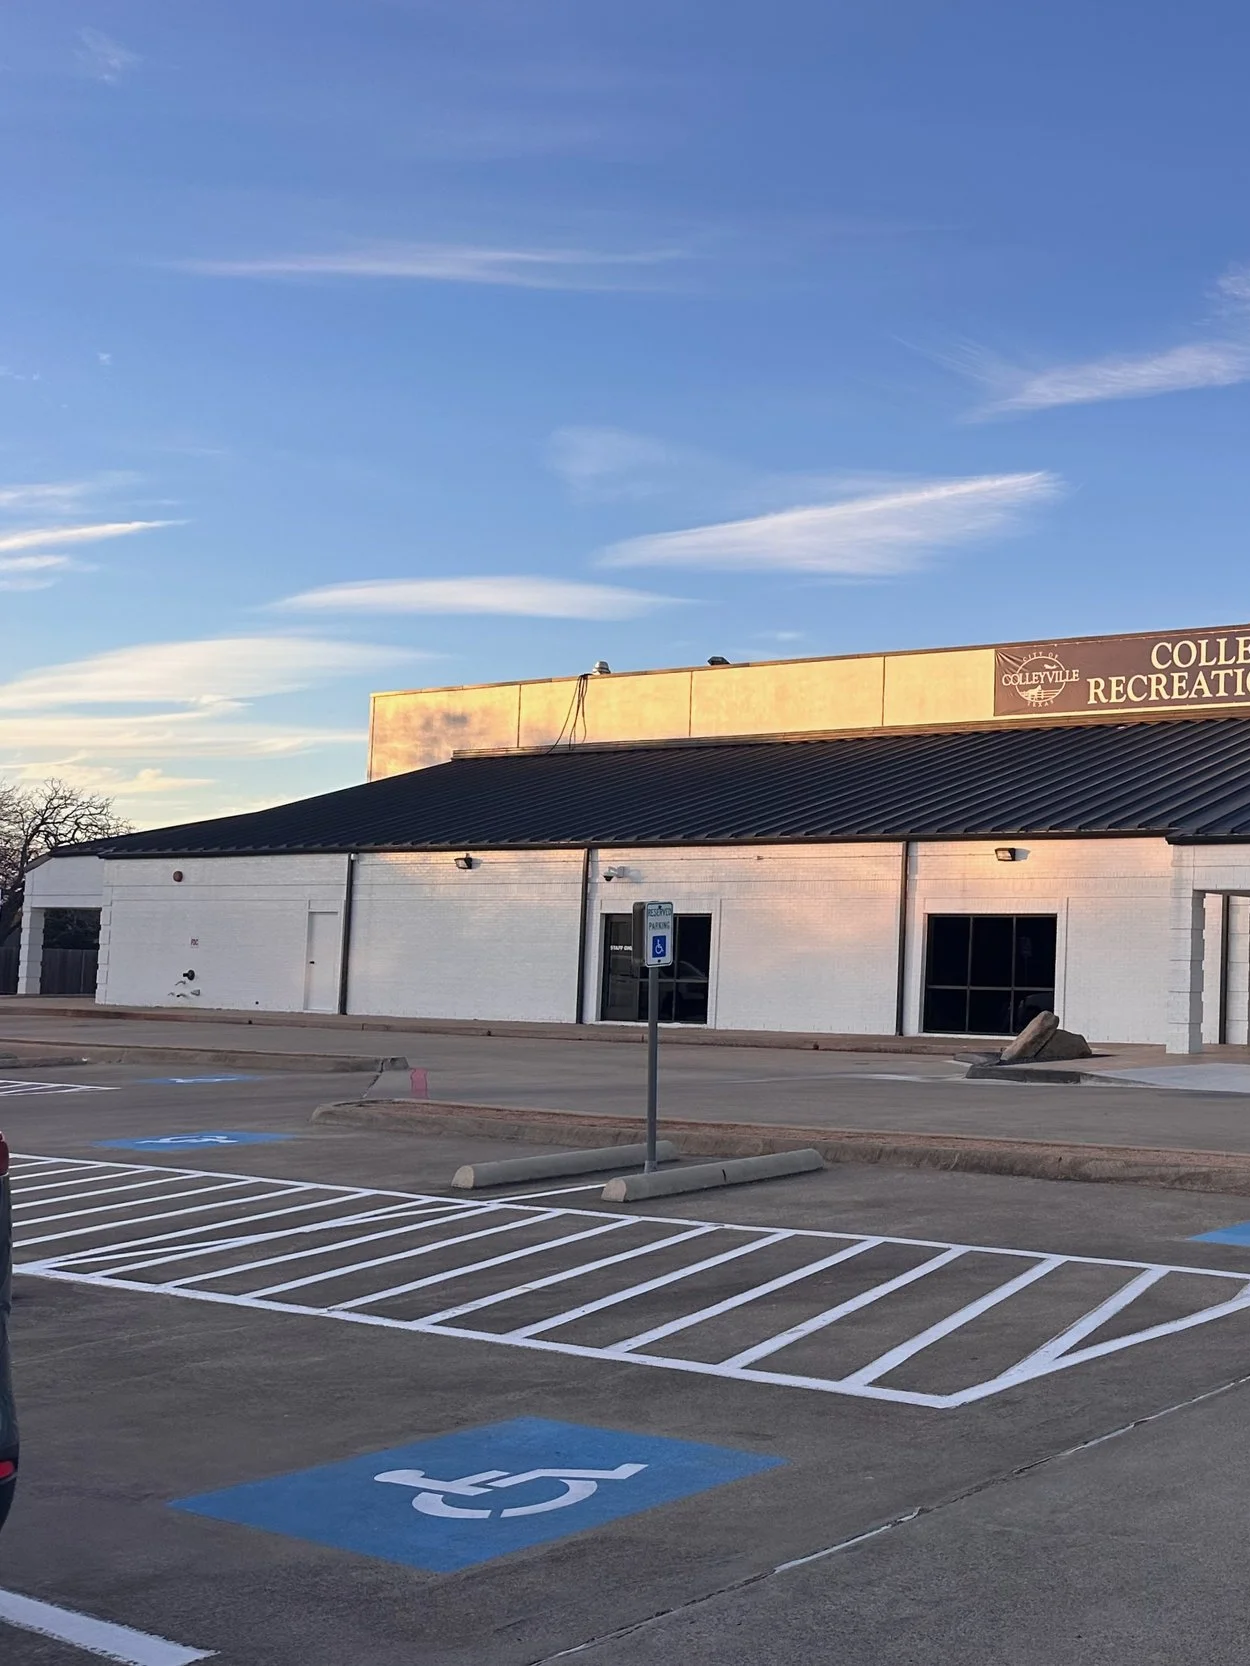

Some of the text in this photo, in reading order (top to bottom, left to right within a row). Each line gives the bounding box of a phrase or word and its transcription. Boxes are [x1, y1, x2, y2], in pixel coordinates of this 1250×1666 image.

[1023, 652, 1059, 662] CITY OF
[1002, 669, 1080, 686] COLLEYVILLE
[1027, 699, 1054, 708] TEXAS
[648, 908, 672, 917] RESERVED
[649, 921, 670, 930] PARKING
